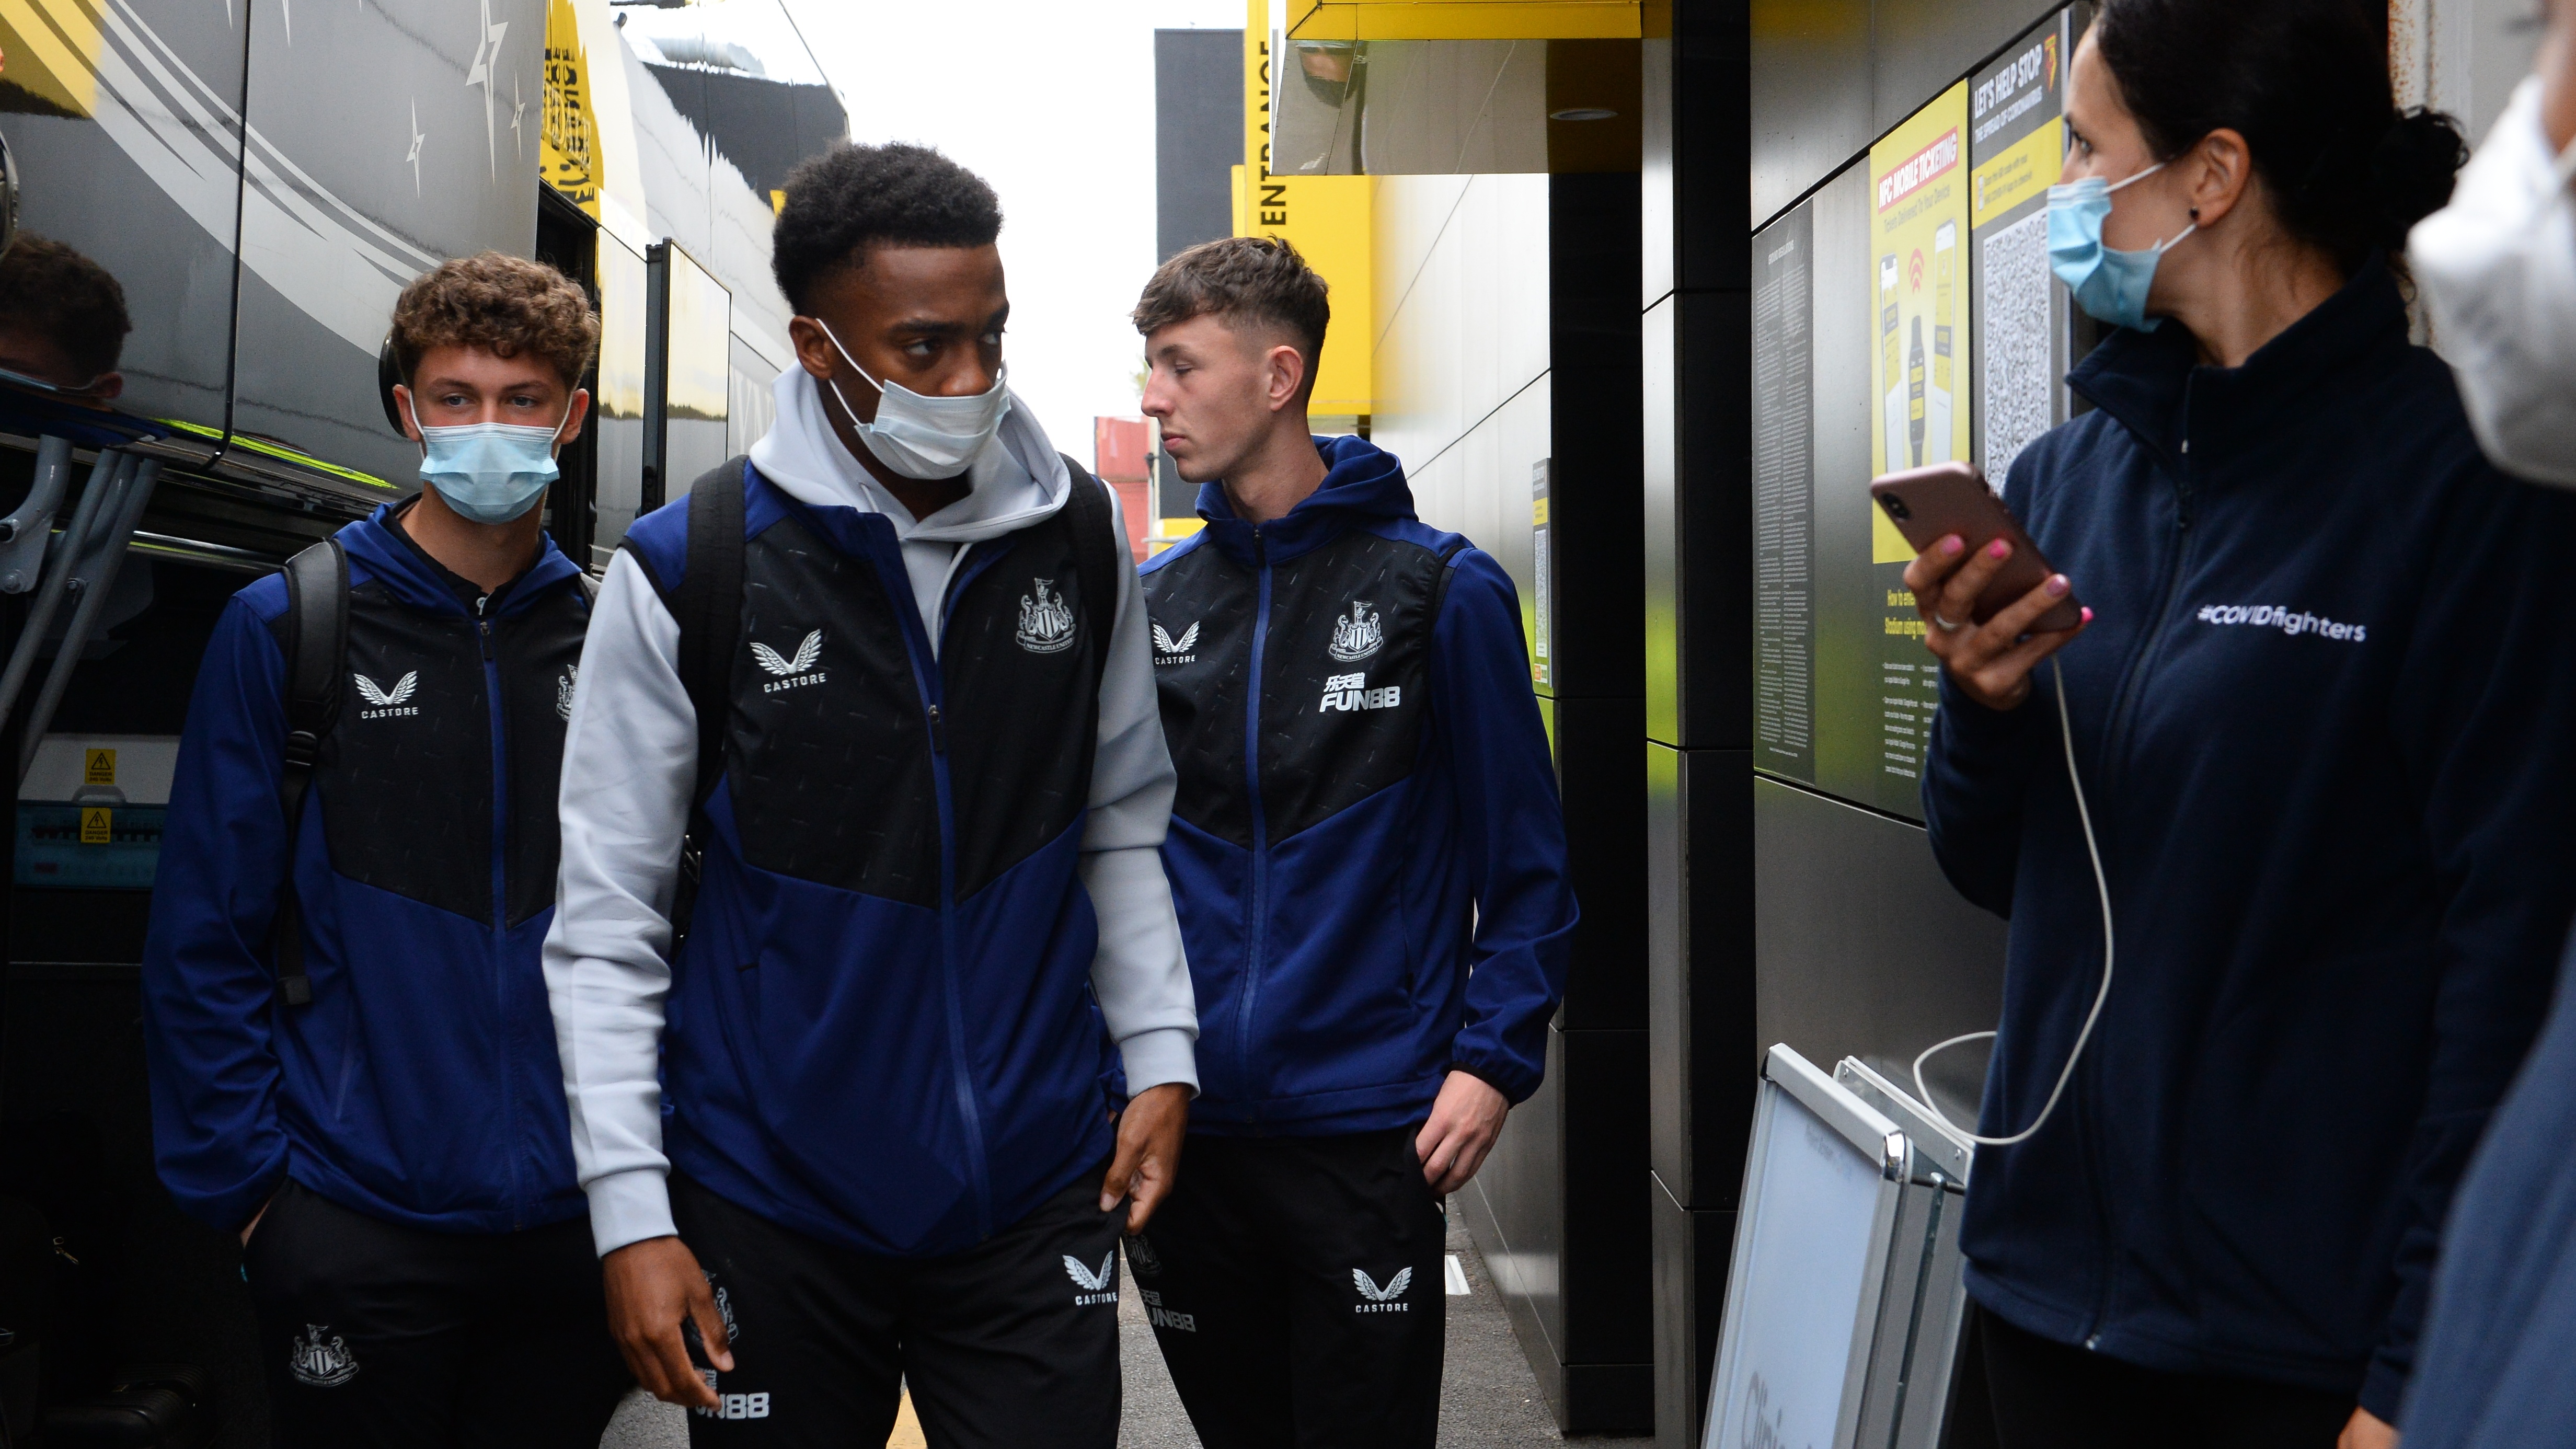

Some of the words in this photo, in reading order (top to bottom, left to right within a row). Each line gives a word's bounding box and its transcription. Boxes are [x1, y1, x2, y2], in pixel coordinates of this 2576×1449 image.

[1974, 78, 1995, 119] LET'S
[1995, 62, 2017, 105] HELP
[2018, 43, 2043, 88] STOP
[1879, 176, 1893, 209] NFC
[1893, 158, 1919, 200] MOBILE
[1919, 132, 1958, 182] TICKETING
[1898, 589, 1903, 606] to
[2197, 604, 2366, 642] #COVIDfighters
[1154, 654, 1195, 665] CASTORE
[1360, 647, 1376, 657] UNITED
[763, 673, 827, 693] CASTORE
[1323, 672, 1365, 693] 乐天堂
[1319, 686, 1401, 712] FUN88
[361, 707, 419, 719] CASTORE
[1075, 1292, 1118, 1306] CASTORE
[1137, 1285, 1163, 1307] 天堂
[1355, 1303, 1408, 1313] CASTORE
[1146, 1306, 1196, 1332] UN88
